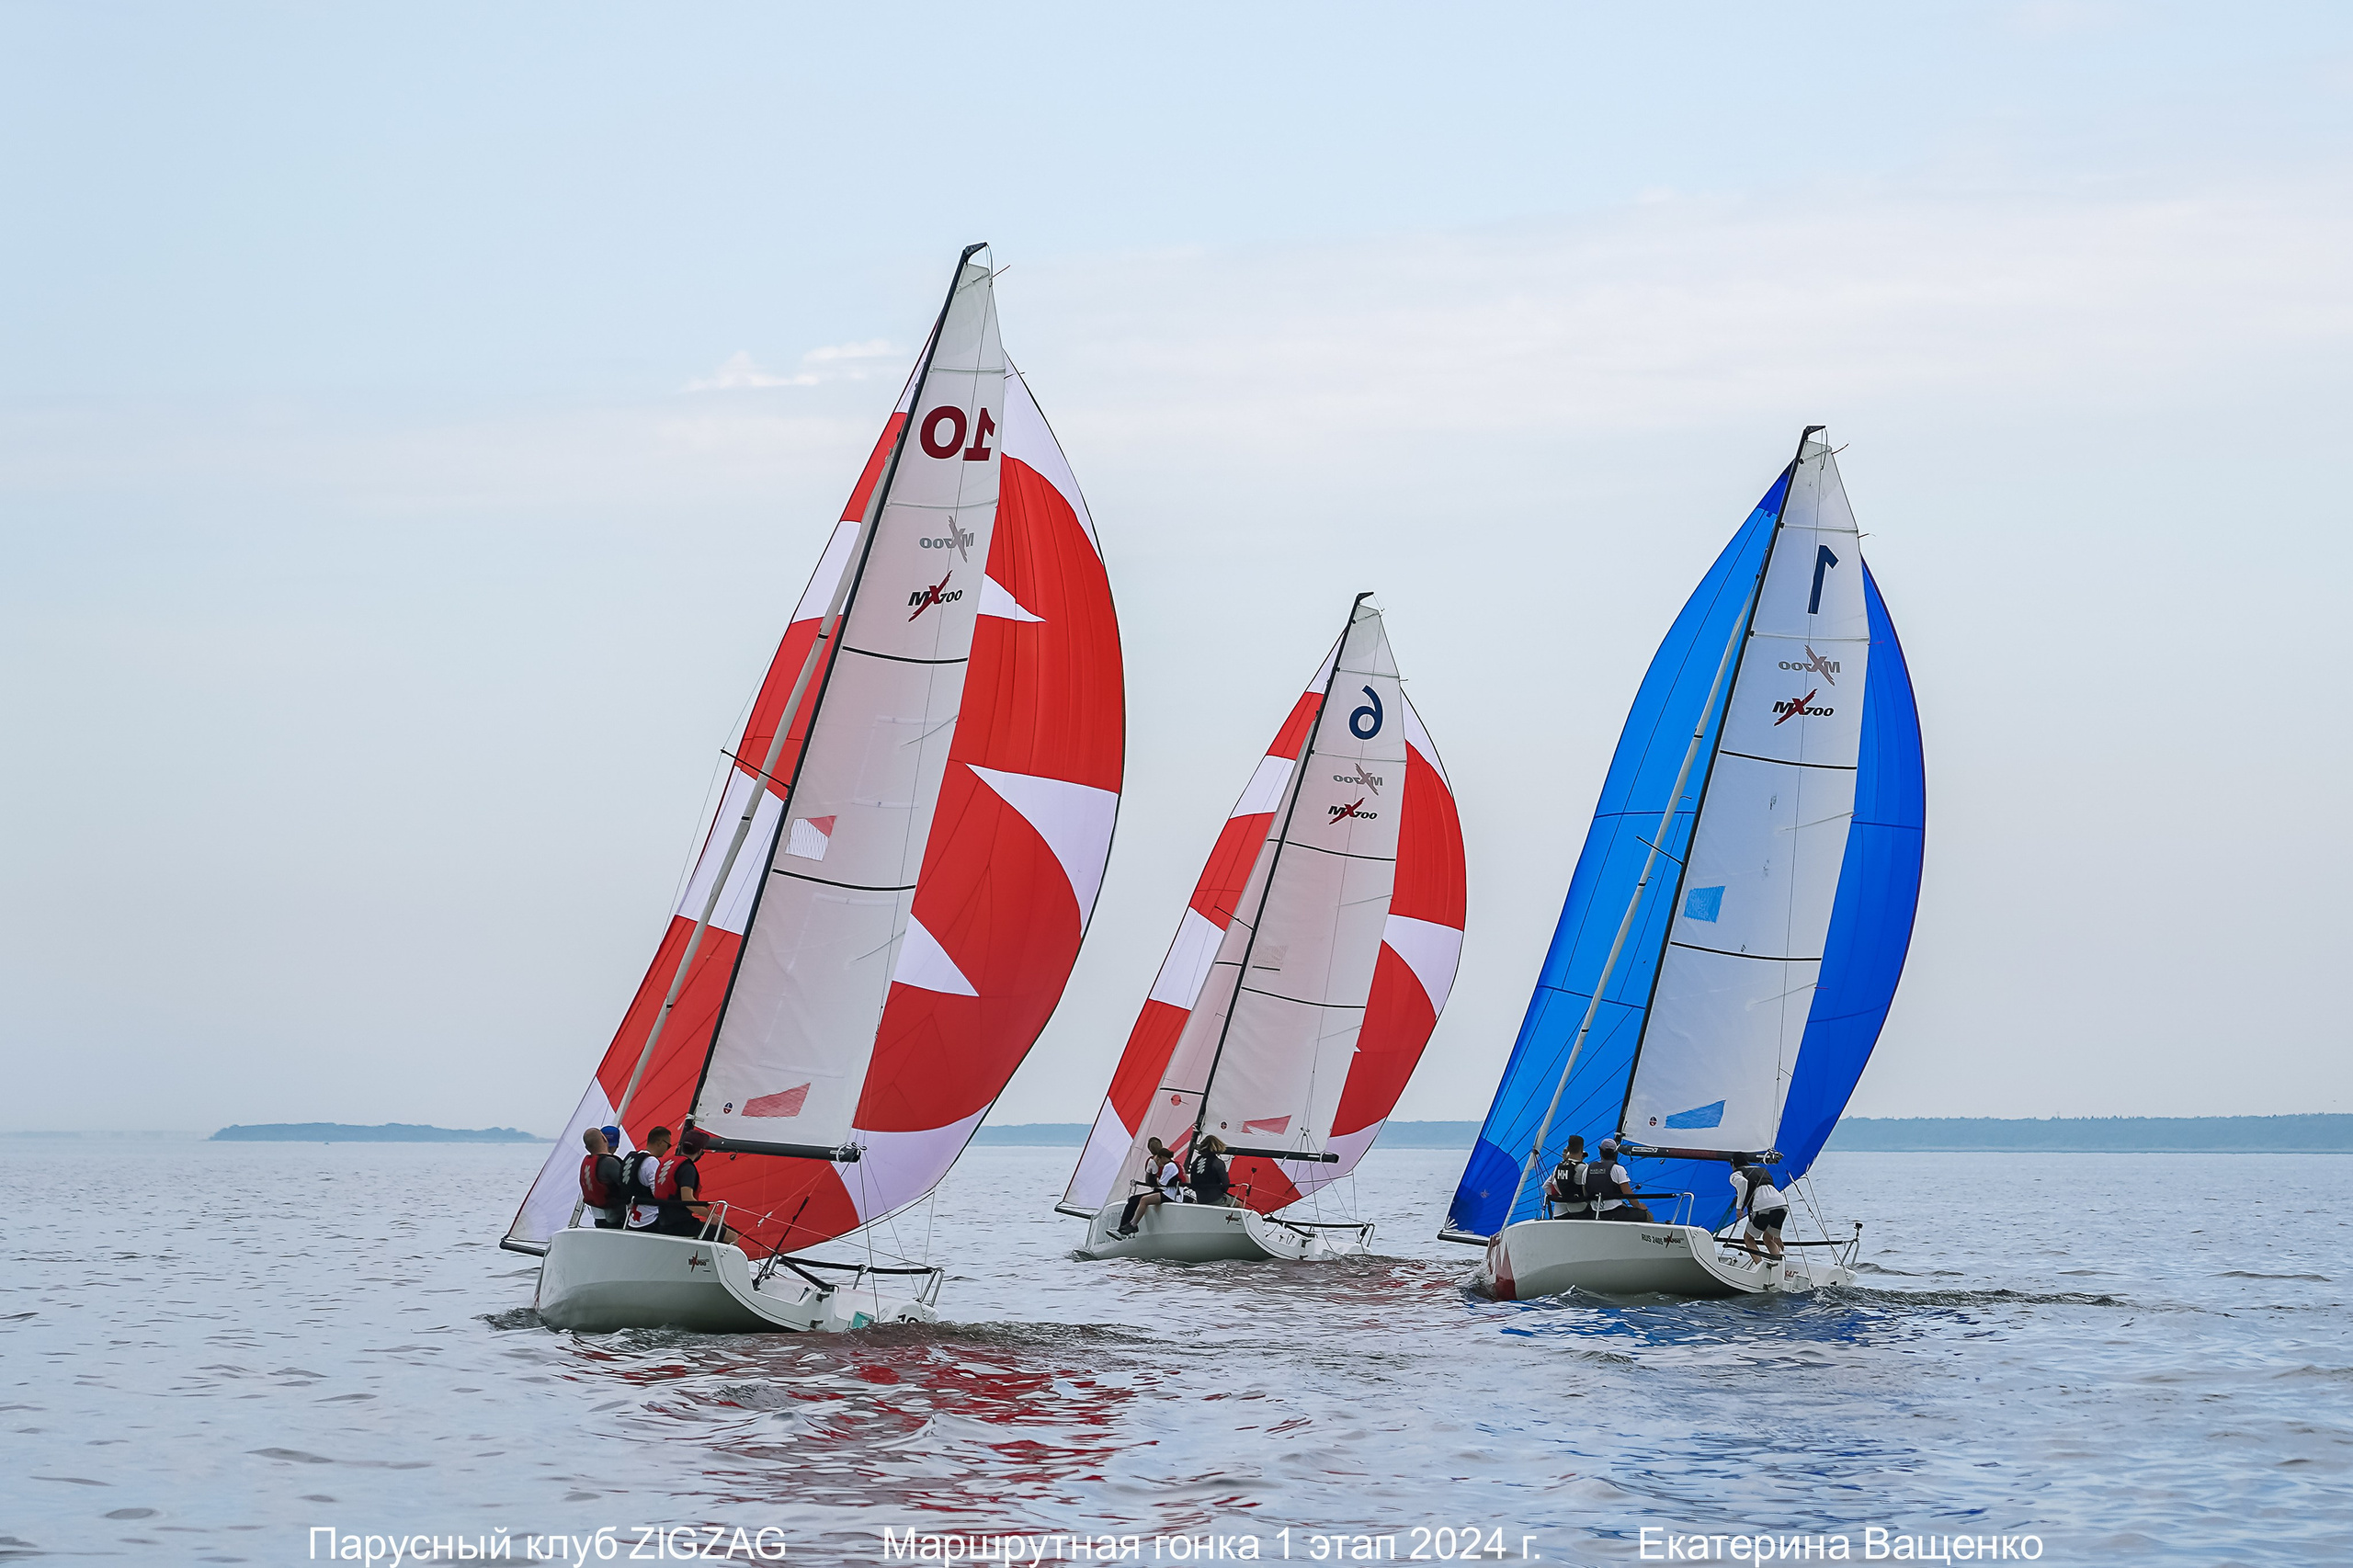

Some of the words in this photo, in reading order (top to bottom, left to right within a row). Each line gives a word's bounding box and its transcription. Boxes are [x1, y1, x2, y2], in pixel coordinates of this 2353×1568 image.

[907, 570, 963, 622] MX700
[1772, 688, 1835, 727] MX700
[1327, 797, 1378, 825] MX700
